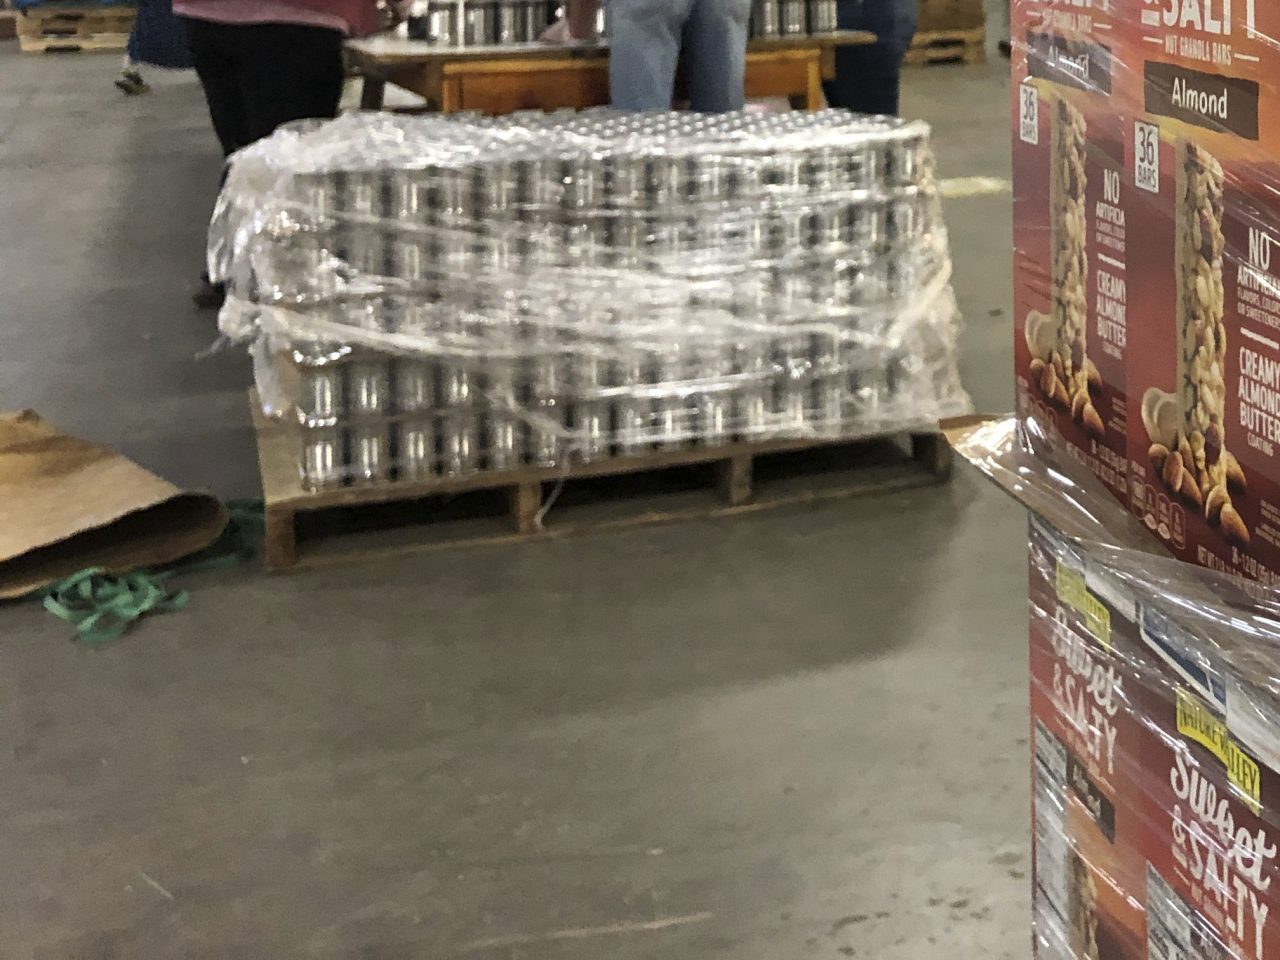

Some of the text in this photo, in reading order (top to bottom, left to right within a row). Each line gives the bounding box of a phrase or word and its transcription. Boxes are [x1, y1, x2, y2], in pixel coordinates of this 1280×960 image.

[1165, 33, 1232, 65] NUT GRANOLA BARS
[1022, 89, 1036, 121] 36
[1171, 76, 1228, 120] Almond
[1138, 125, 1155, 166] 36
[1103, 168, 1120, 205] NO
[1137, 163, 1158, 189] BARS
[1248, 226, 1271, 271] NO
[1239, 346, 1280, 391] CREAMY
[1170, 742, 1277, 891] Sweet
